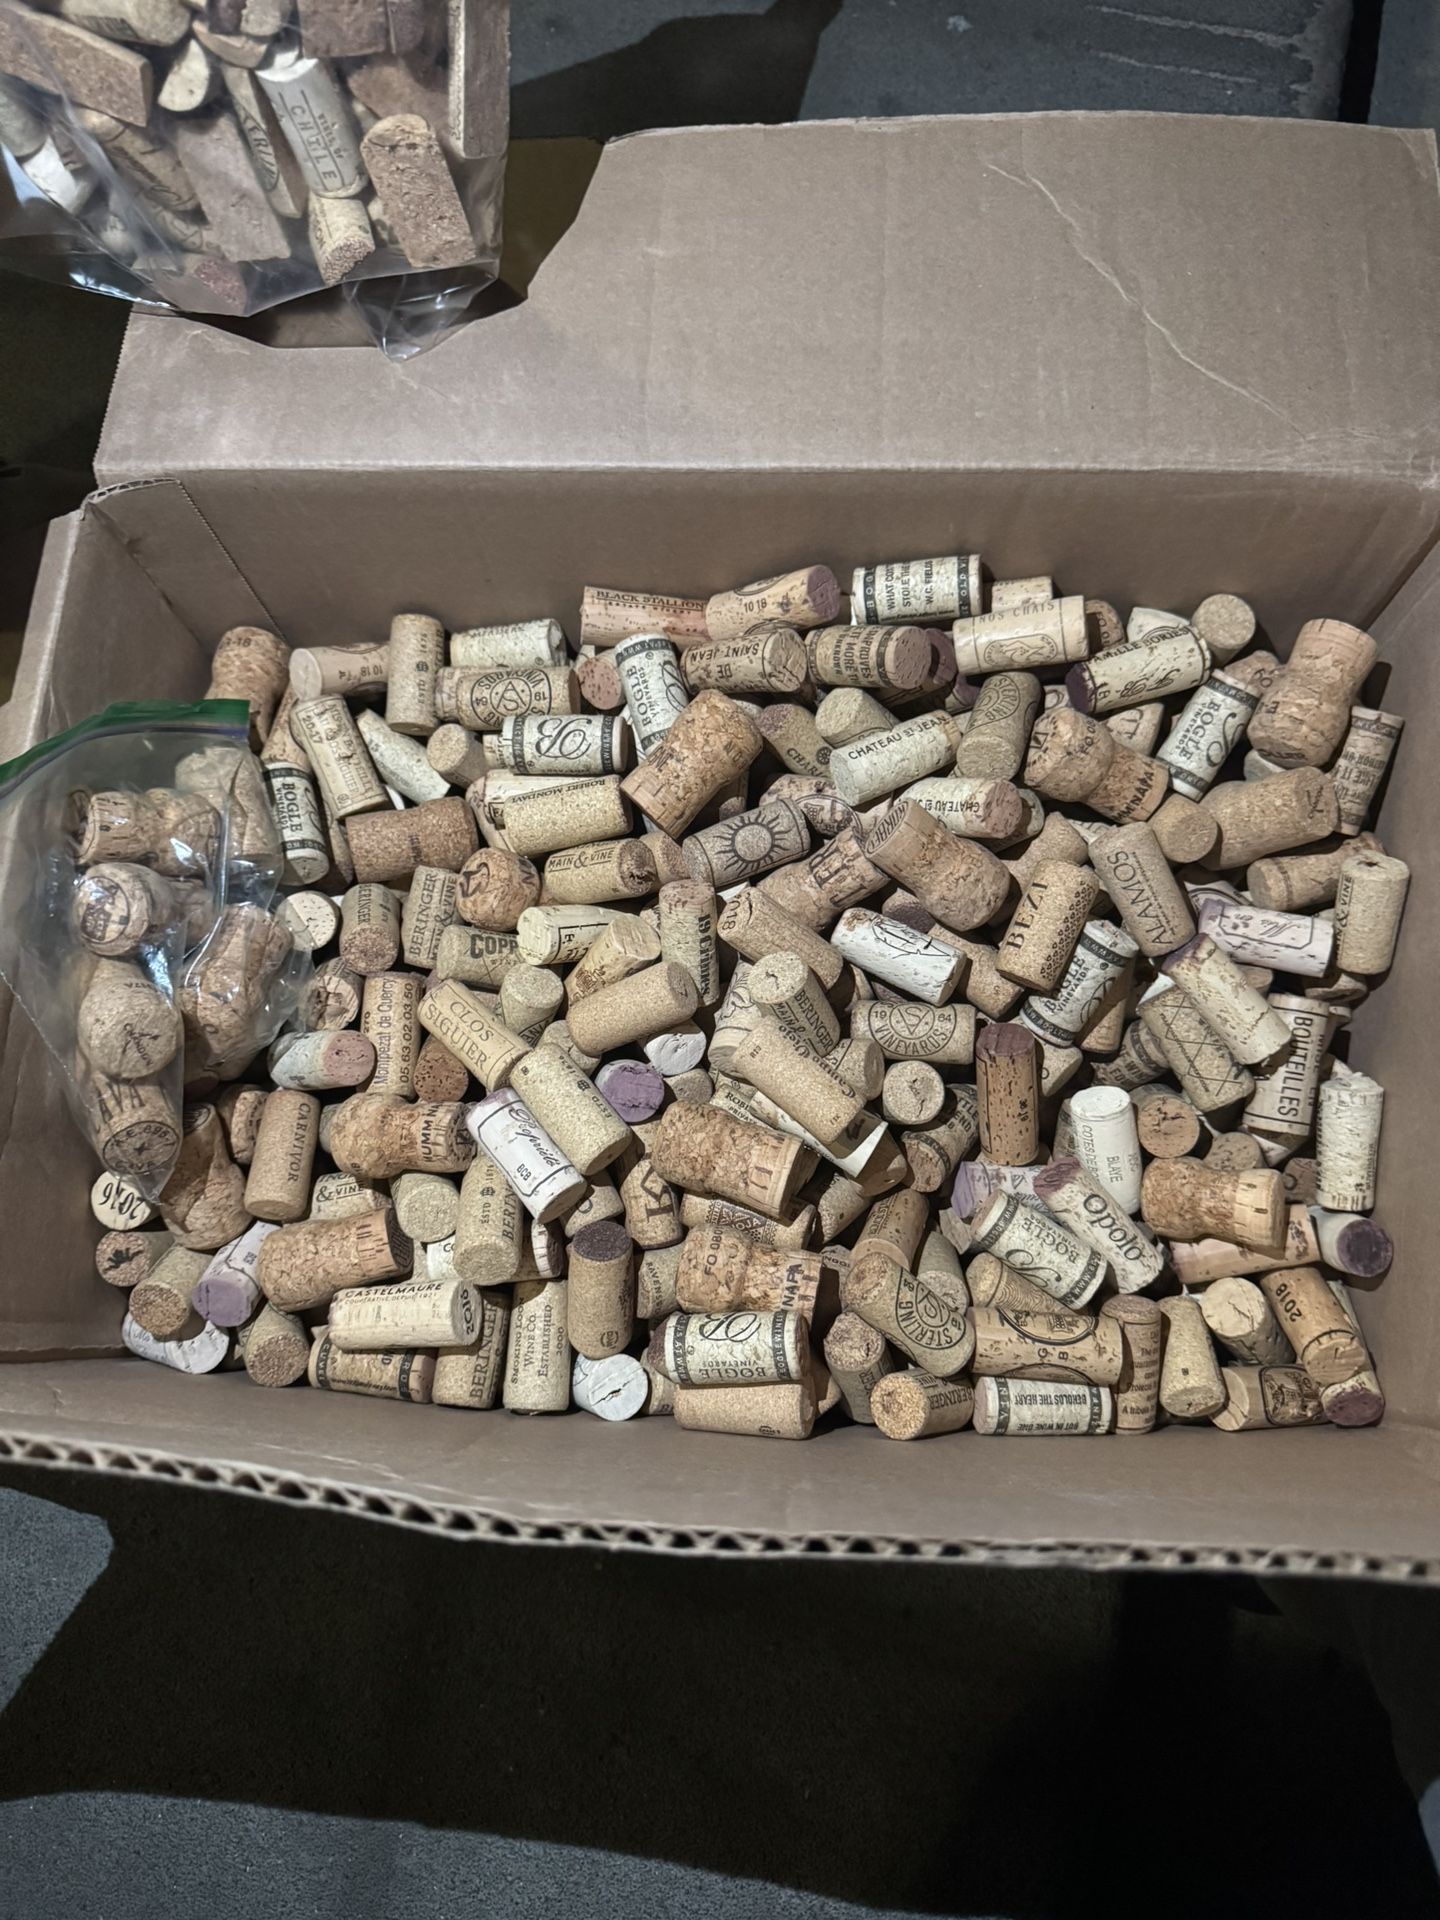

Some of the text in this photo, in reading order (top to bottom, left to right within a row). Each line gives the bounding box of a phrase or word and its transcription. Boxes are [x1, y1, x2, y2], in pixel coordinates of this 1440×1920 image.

[290, 104, 338, 180] CHILE
[596, 590, 706, 609] BLACK STALLION
[886, 587, 896, 611] WHAT
[901, 581, 911, 608] STOLE
[843, 640, 856, 673] MORE
[1086, 626, 1190, 666] FAMILLE BORIES
[717, 663, 734, 680] DE
[627, 664, 652, 727] BOGLE
[848, 732, 903, 762] CHATEAU
[916, 714, 949, 735] JEAN
[1178, 699, 1222, 762] BOGLE
[281, 781, 303, 834] BOGLE
[933, 800, 981, 815] CHATEAU
[548, 856, 574, 869] MAIN
[589, 850, 615, 863] VINE
[1107, 850, 1173, 946] ALAMOS
[1340, 875, 1352, 909] VINE
[409, 873, 438, 959] BERINGER
[471, 933, 520, 959] COPP
[698, 913, 713, 996] 19 Crimes
[1056, 965, 1090, 1013] VINEYARDS
[379, 1015, 392, 1029] de
[450, 1000, 495, 1043] CLOS
[794, 989, 835, 1056] BERINGER
[873, 1009, 887, 1020] 19
[424, 1002, 489, 1072] SIGUIER
[874, 1024, 951, 1056] VINEYARDS
[778, 1023, 858, 1099] Campo Viejo
[1276, 1015, 1315, 1118] BOUTEILLES
[287, 1102, 311, 1183] CARNIVOR
[515, 1162, 533, 1182] BCB
[1106, 1155, 1124, 1184] BLAYE
[99, 1181, 143, 1219] 2016
[334, 1183, 365, 1197] VINE
[502, 1187, 517, 1242] BERIN
[1082, 1193, 1145, 1262] Opolo
[1020, 1215, 1081, 1265] BOGLE
[344, 1282, 444, 1298] CASTELMAURE
[1275, 1282, 1304, 1324] 2018
[510, 1296, 526, 1385] SMOKING LOON
[556, 1325, 566, 1357] 2000
[899, 1300, 953, 1347] STERLING
[469, 1304, 499, 1401] BERINGER
[700, 1365, 767, 1381] BOGLE
[928, 1386, 975, 1411] BERINGER
[1013, 1394, 1038, 1406] HEART
[1038, 1393, 1054, 1406] THE
